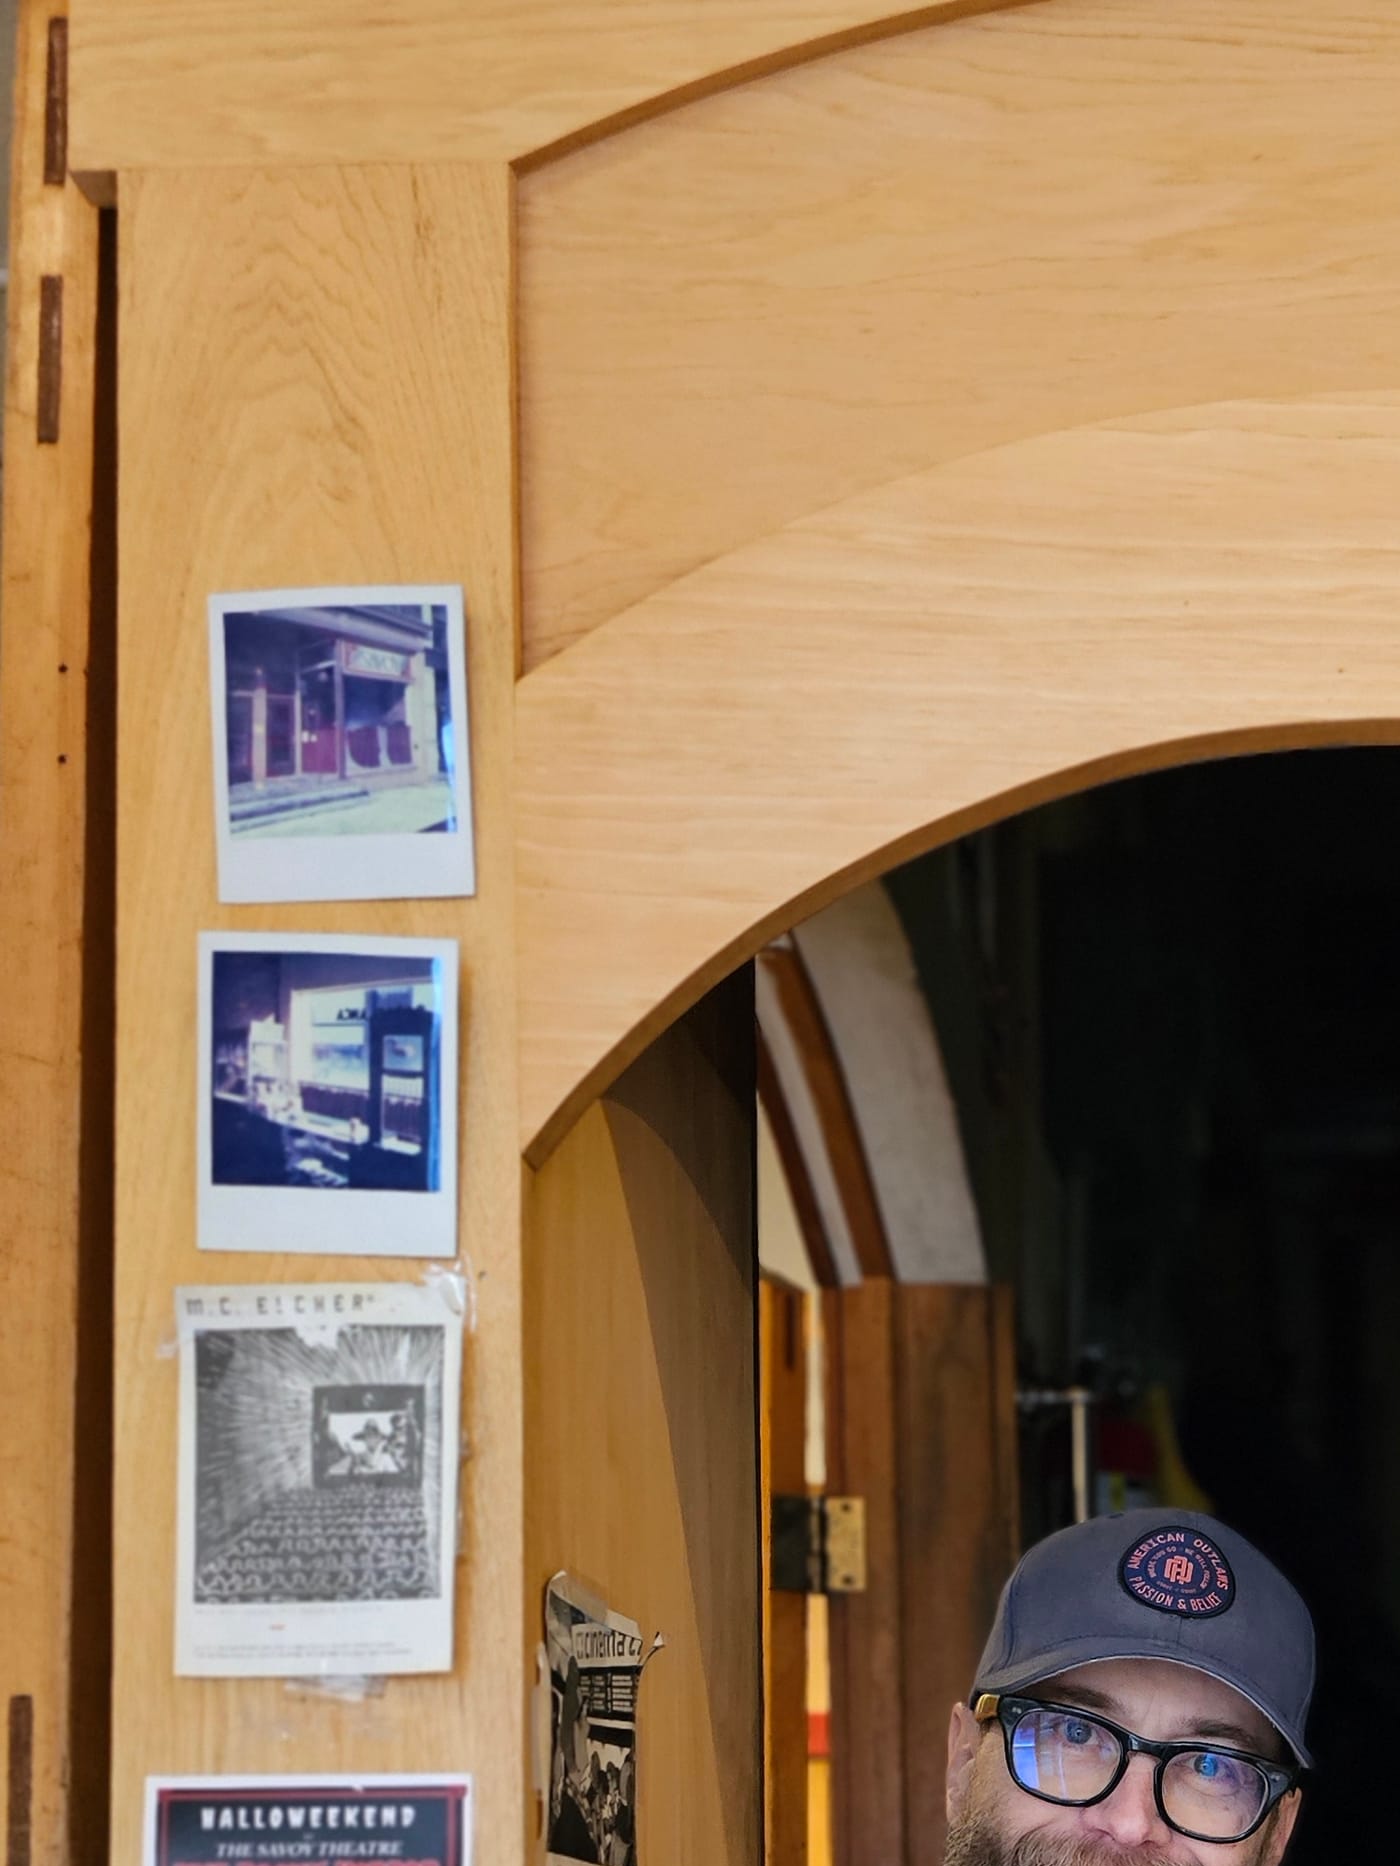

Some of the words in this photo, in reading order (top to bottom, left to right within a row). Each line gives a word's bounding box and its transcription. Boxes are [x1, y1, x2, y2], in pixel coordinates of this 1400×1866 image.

[1127, 1533, 1185, 1569] AMERICAN
[1193, 1538, 1229, 1590] OUTLAWS
[1129, 1576, 1174, 1607] PASSION
[1177, 1598, 1187, 1610] &
[1190, 1591, 1222, 1611] BELIEF
[201, 1806, 416, 1830] HALLOWEEKEND
